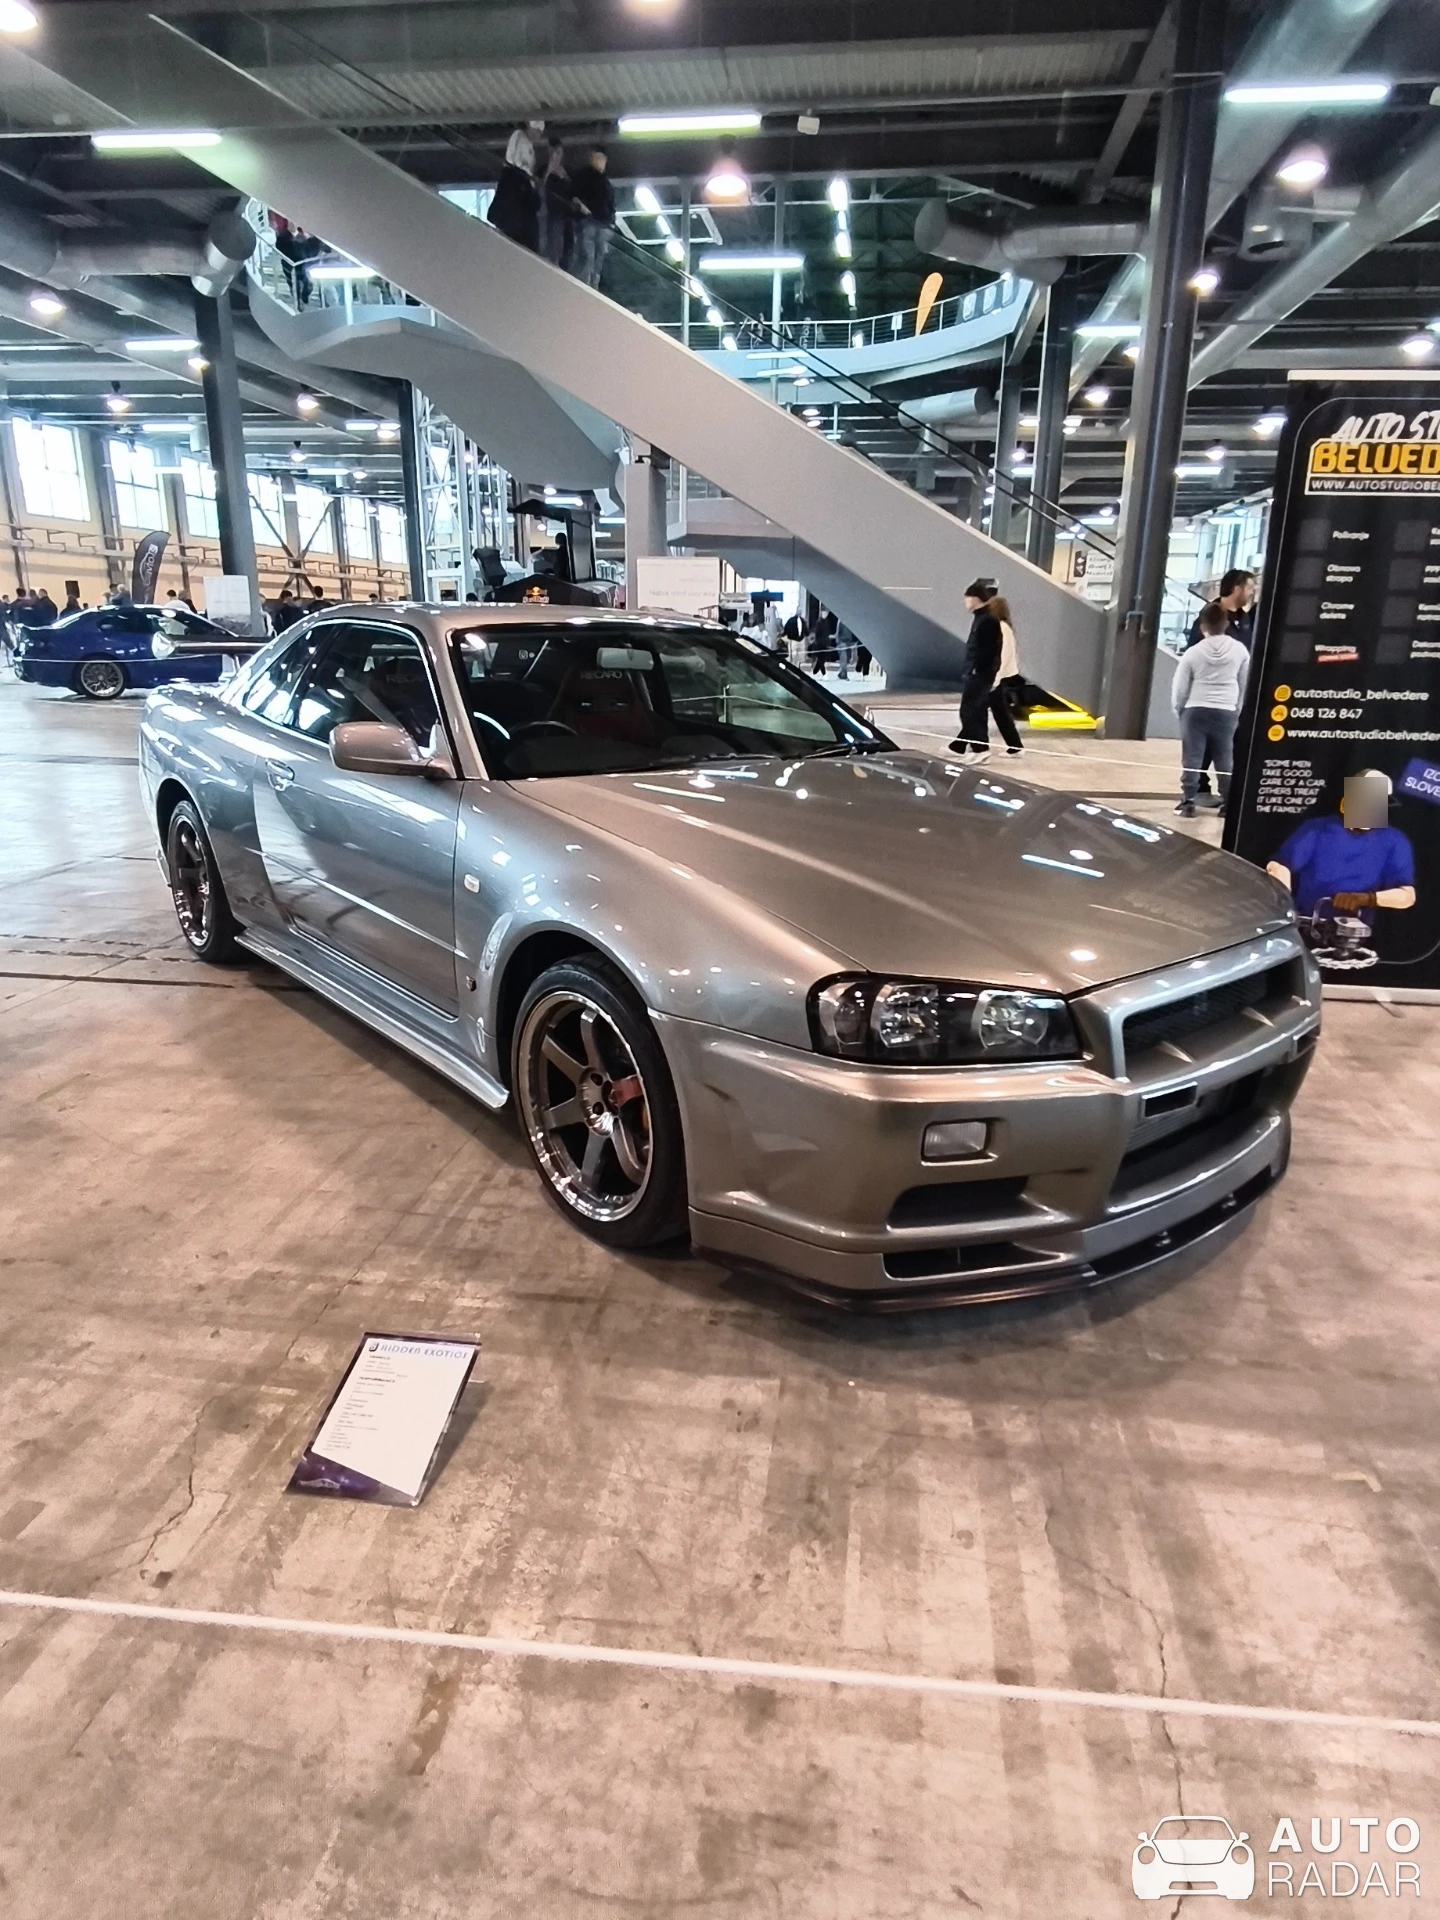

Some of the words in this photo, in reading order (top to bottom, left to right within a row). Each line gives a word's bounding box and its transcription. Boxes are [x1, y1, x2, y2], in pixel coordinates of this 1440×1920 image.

[1331, 412, 1406, 448] AUTO
[1409, 410, 1440, 441] ST
[1293, 688, 1429, 701] autostudio_belvedere
[1290, 708, 1314, 718] 068
[1318, 708, 1337, 719] 126
[1339, 709, 1363, 719] 847
[1283, 769, 1312, 777] GOOD
[1283, 778, 1297, 786] OF
[1258, 787, 1292, 795] OTHERS
[1294, 787, 1320, 796] TREAT
[1265, 796, 1283, 804] LIKE
[1284, 797, 1303, 805] ONE
[1304, 797, 1318, 805] OF
[1256, 805, 1271, 813] THE
